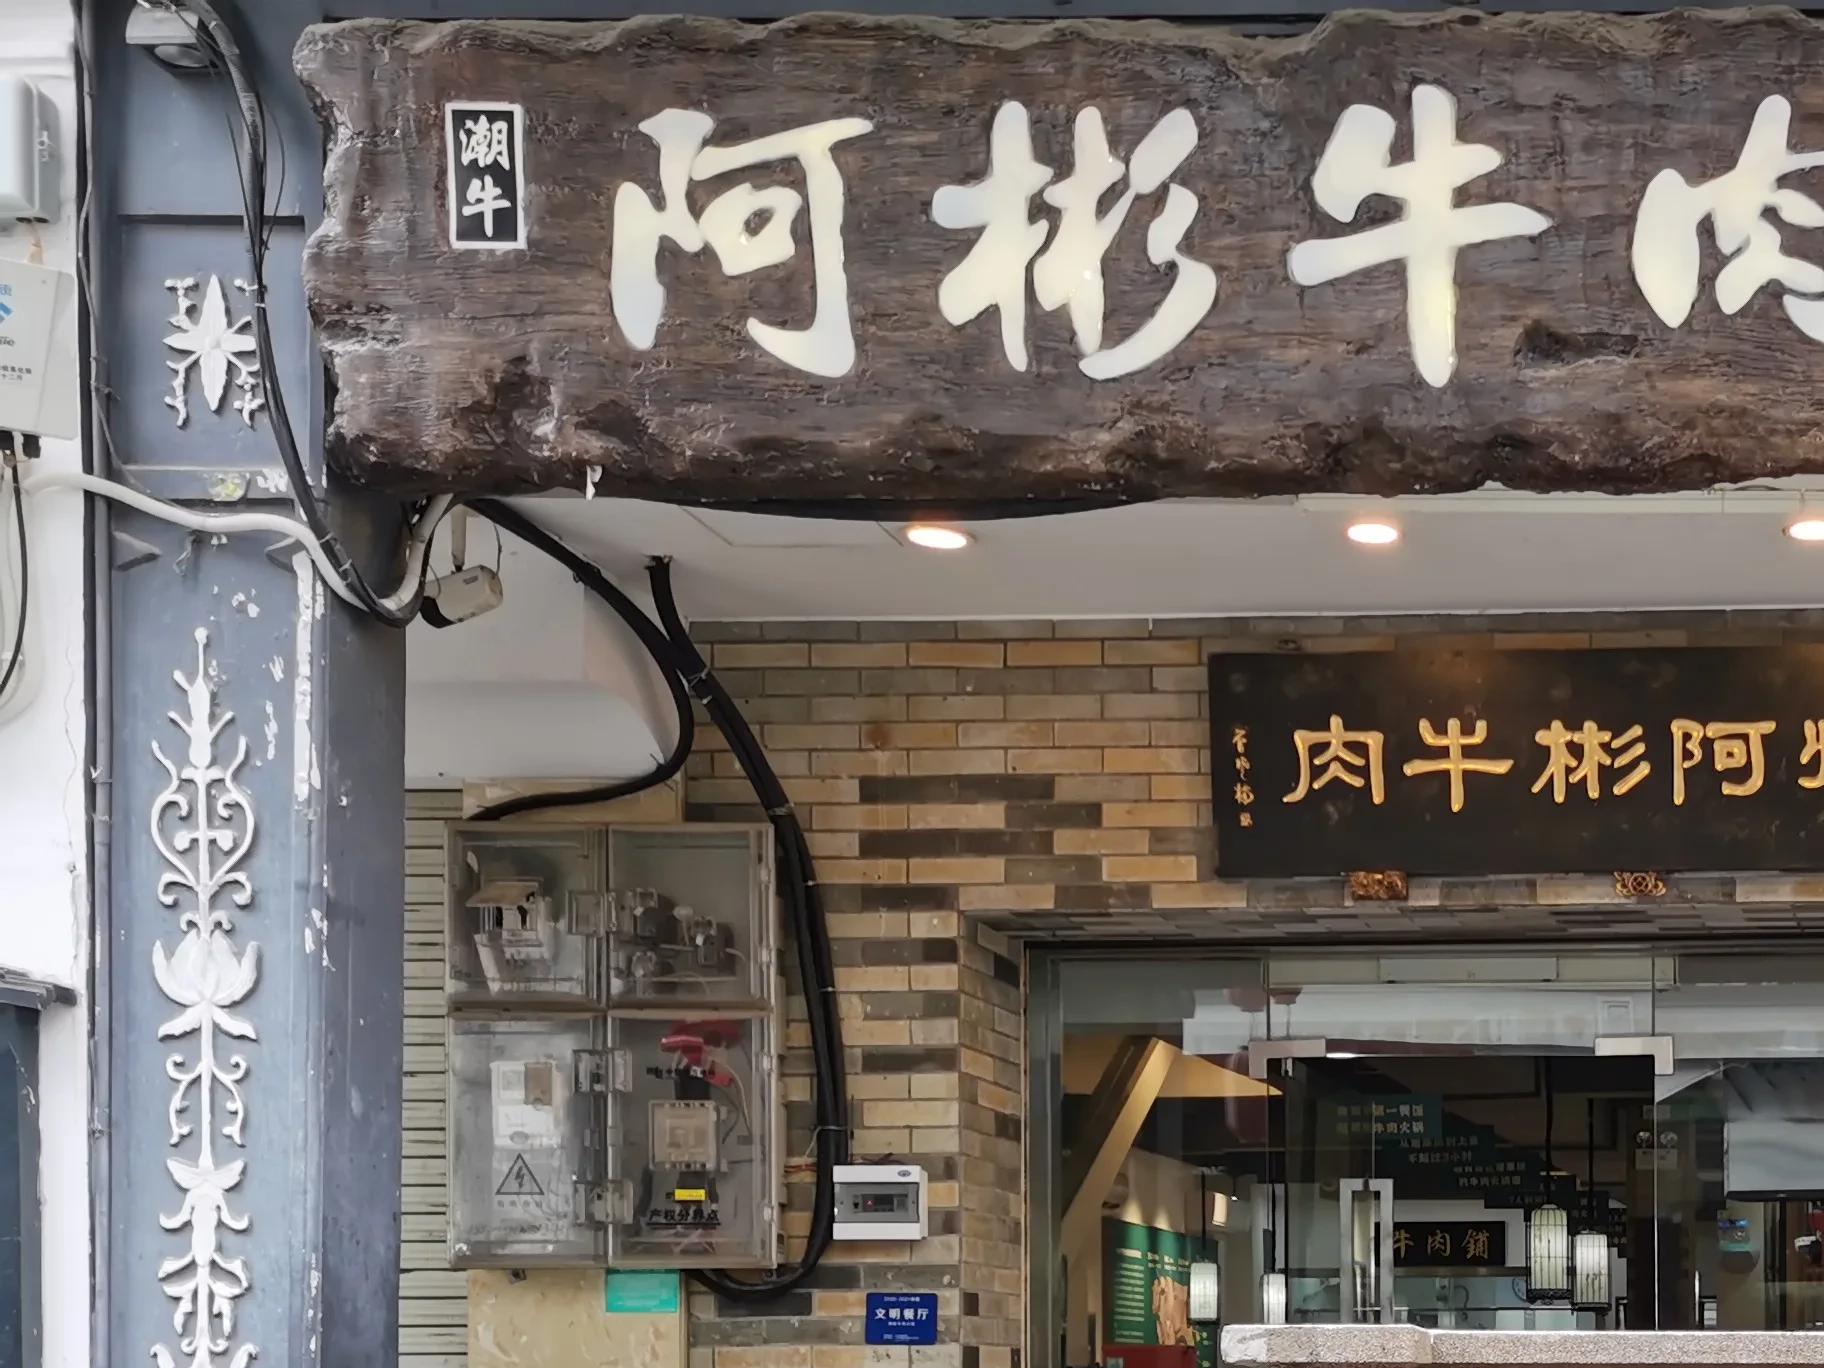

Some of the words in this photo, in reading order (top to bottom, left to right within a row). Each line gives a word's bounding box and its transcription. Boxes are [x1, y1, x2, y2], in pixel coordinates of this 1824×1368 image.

[458, 115, 513, 238] 潮牛
[874, 1308, 929, 1321] 文明餐厅
